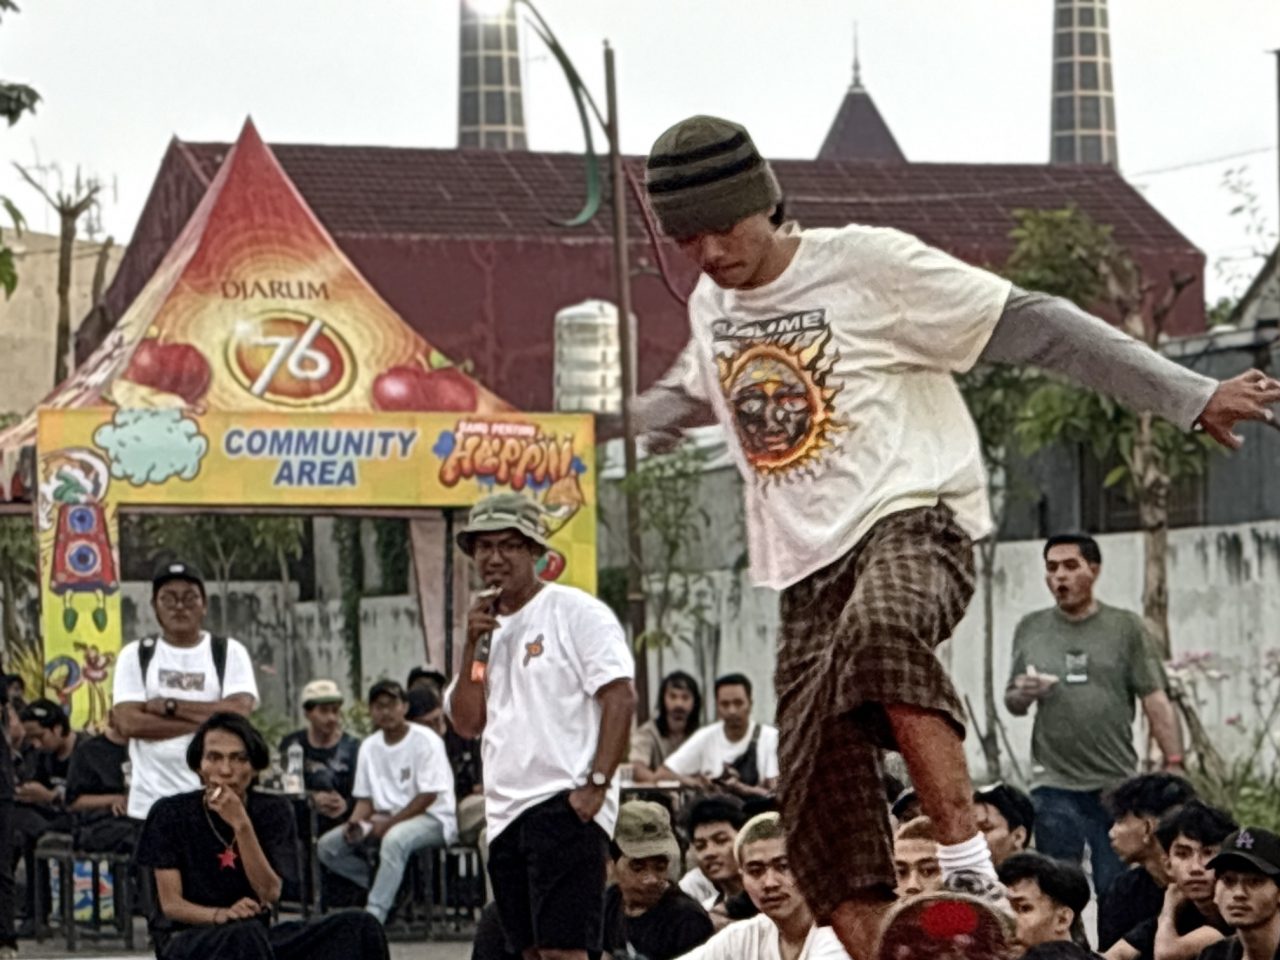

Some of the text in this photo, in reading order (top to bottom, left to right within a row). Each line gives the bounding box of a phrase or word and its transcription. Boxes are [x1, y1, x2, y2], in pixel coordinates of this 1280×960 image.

[221, 280, 330, 301] DJARUM
[247, 318, 331, 397] 76
[225, 429, 417, 457] COMMUNITY
[273, 460, 356, 486] AREA
